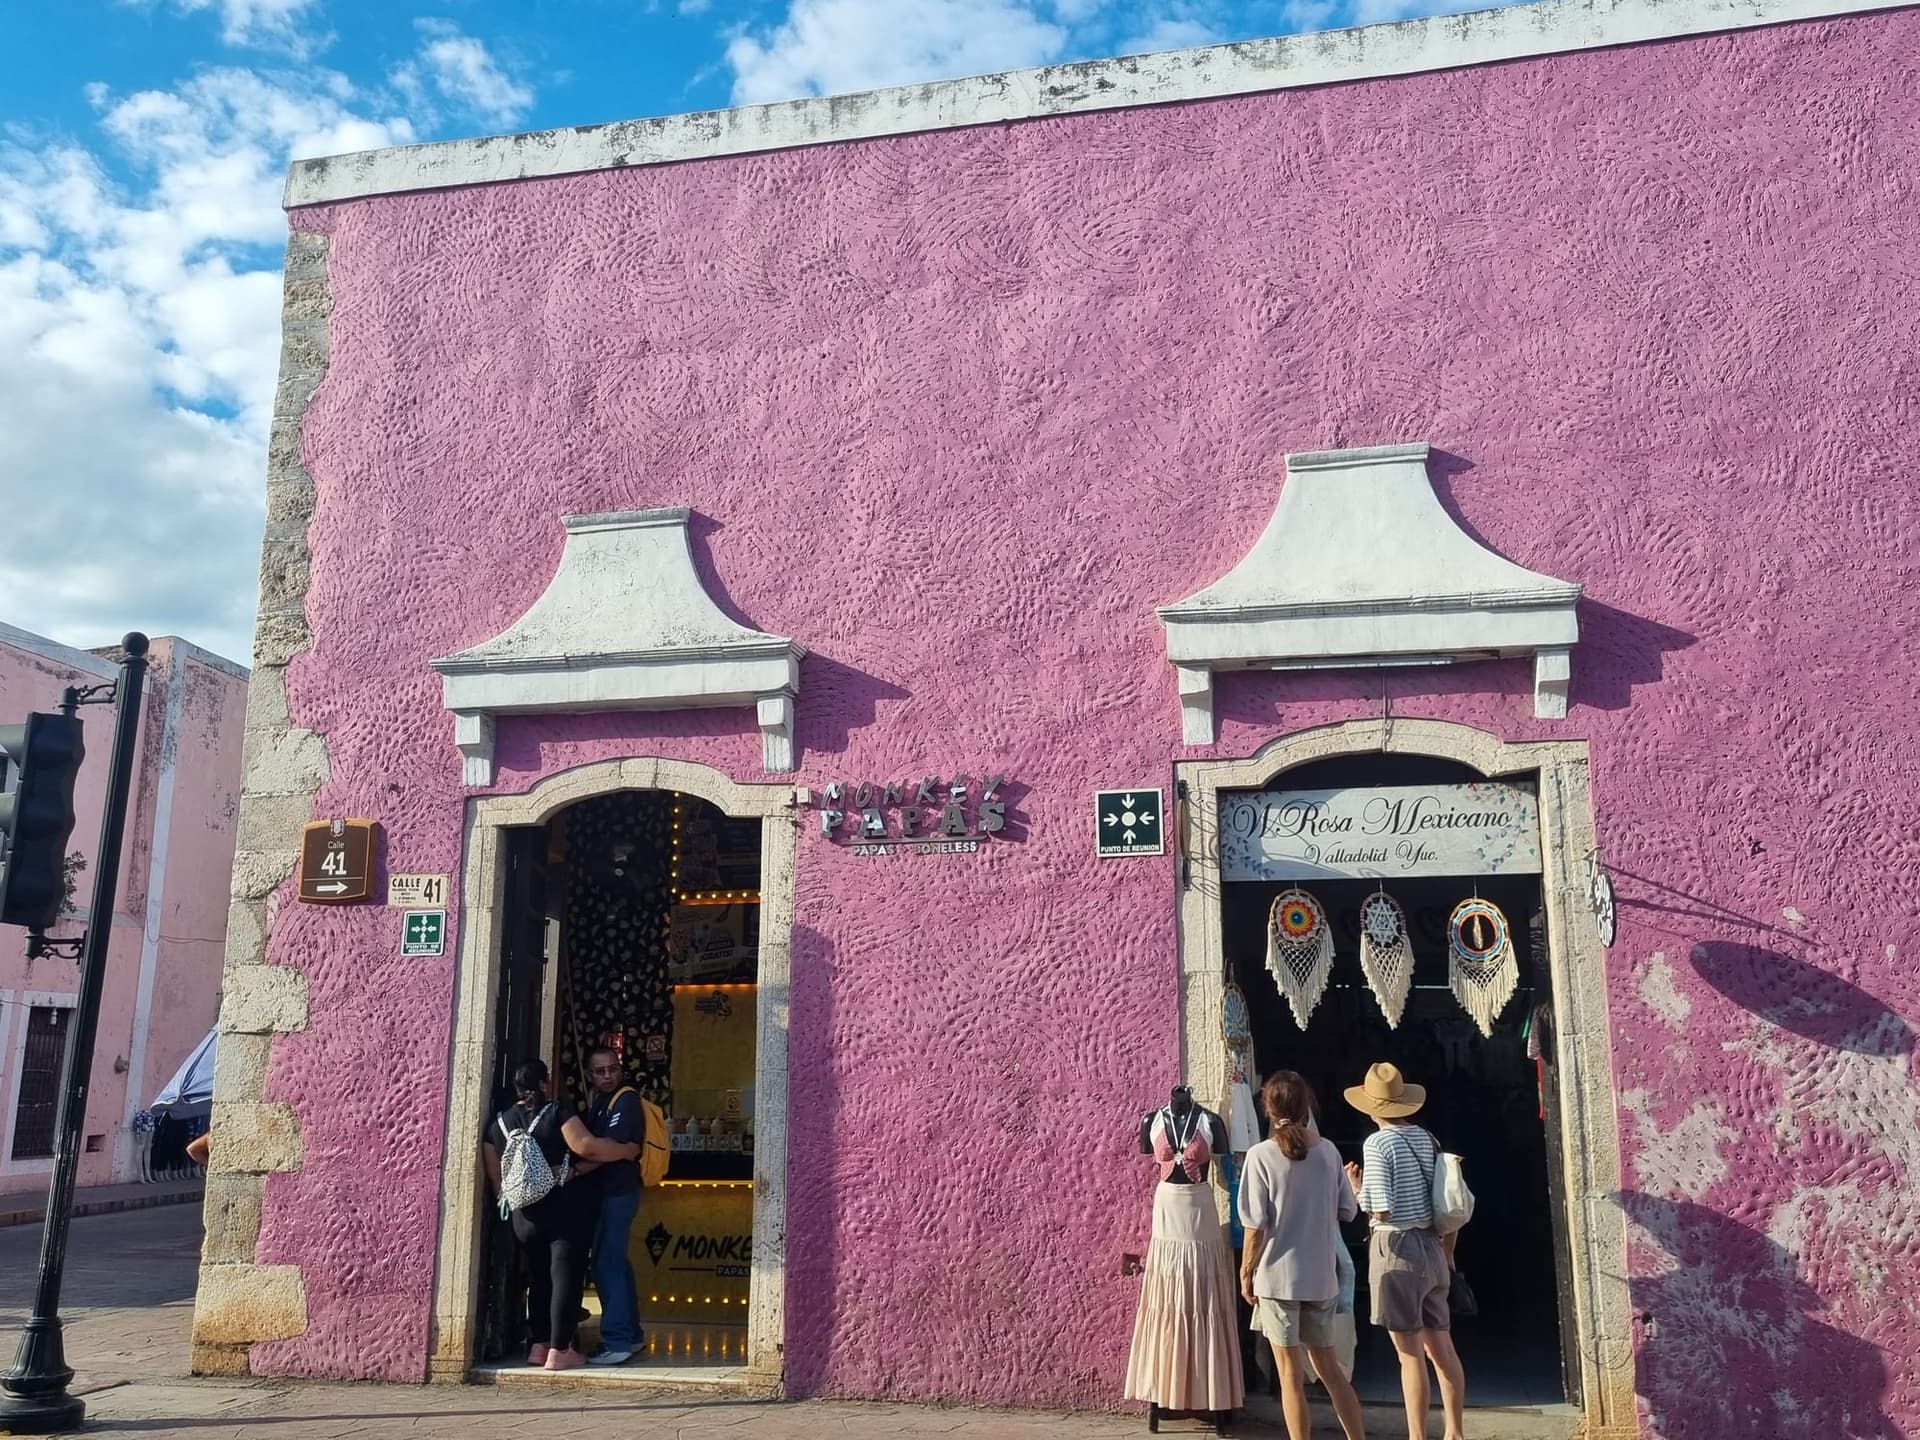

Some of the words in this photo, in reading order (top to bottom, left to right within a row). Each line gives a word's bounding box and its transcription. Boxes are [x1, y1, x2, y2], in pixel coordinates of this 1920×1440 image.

[821, 774, 1004, 809] MONKEY
[820, 802, 1005, 838] PAPAS
[1276, 798, 1353, 838] Rosa
[1361, 795, 1512, 835] Mexicano
[327, 840, 345, 849] Calle
[851, 844, 897, 856] PAPAS
[912, 841, 978, 856] BONELESS
[1100, 845, 1121, 853] PUNTO
[1304, 840, 1388, 865] Valladolid
[1395, 840, 1438, 870] Yuc.
[321, 851, 347, 875] 41
[392, 878, 421, 888] CALLE
[423, 878, 442, 903] 41
